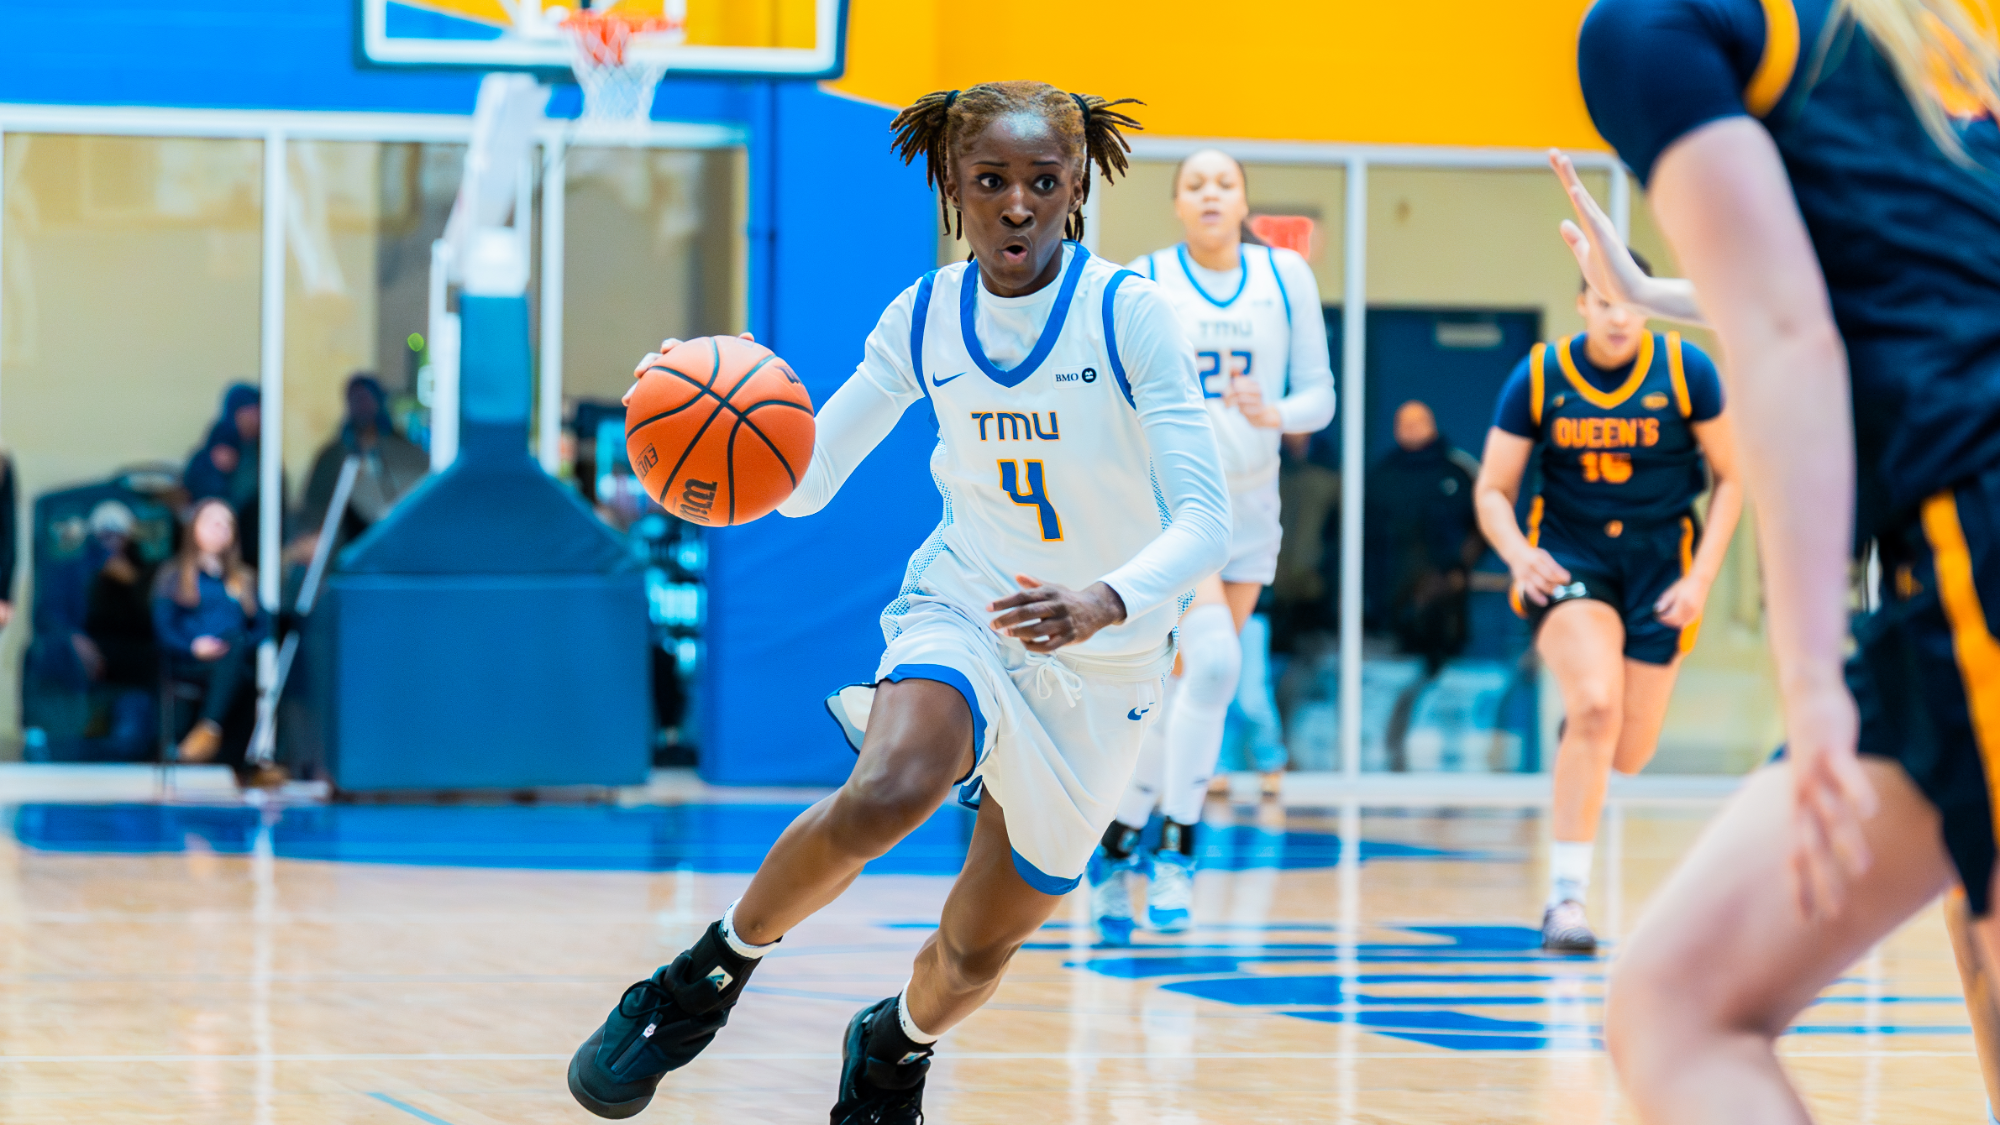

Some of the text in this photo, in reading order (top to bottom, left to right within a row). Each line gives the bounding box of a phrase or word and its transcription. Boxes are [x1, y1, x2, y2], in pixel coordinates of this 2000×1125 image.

[1198, 320, 1253, 338] TMU
[1055, 372, 1080, 382] BMO
[970, 410, 1061, 441] TMU
[1552, 416, 1660, 448] QUEEN'S
[996, 459, 1064, 542] 4
